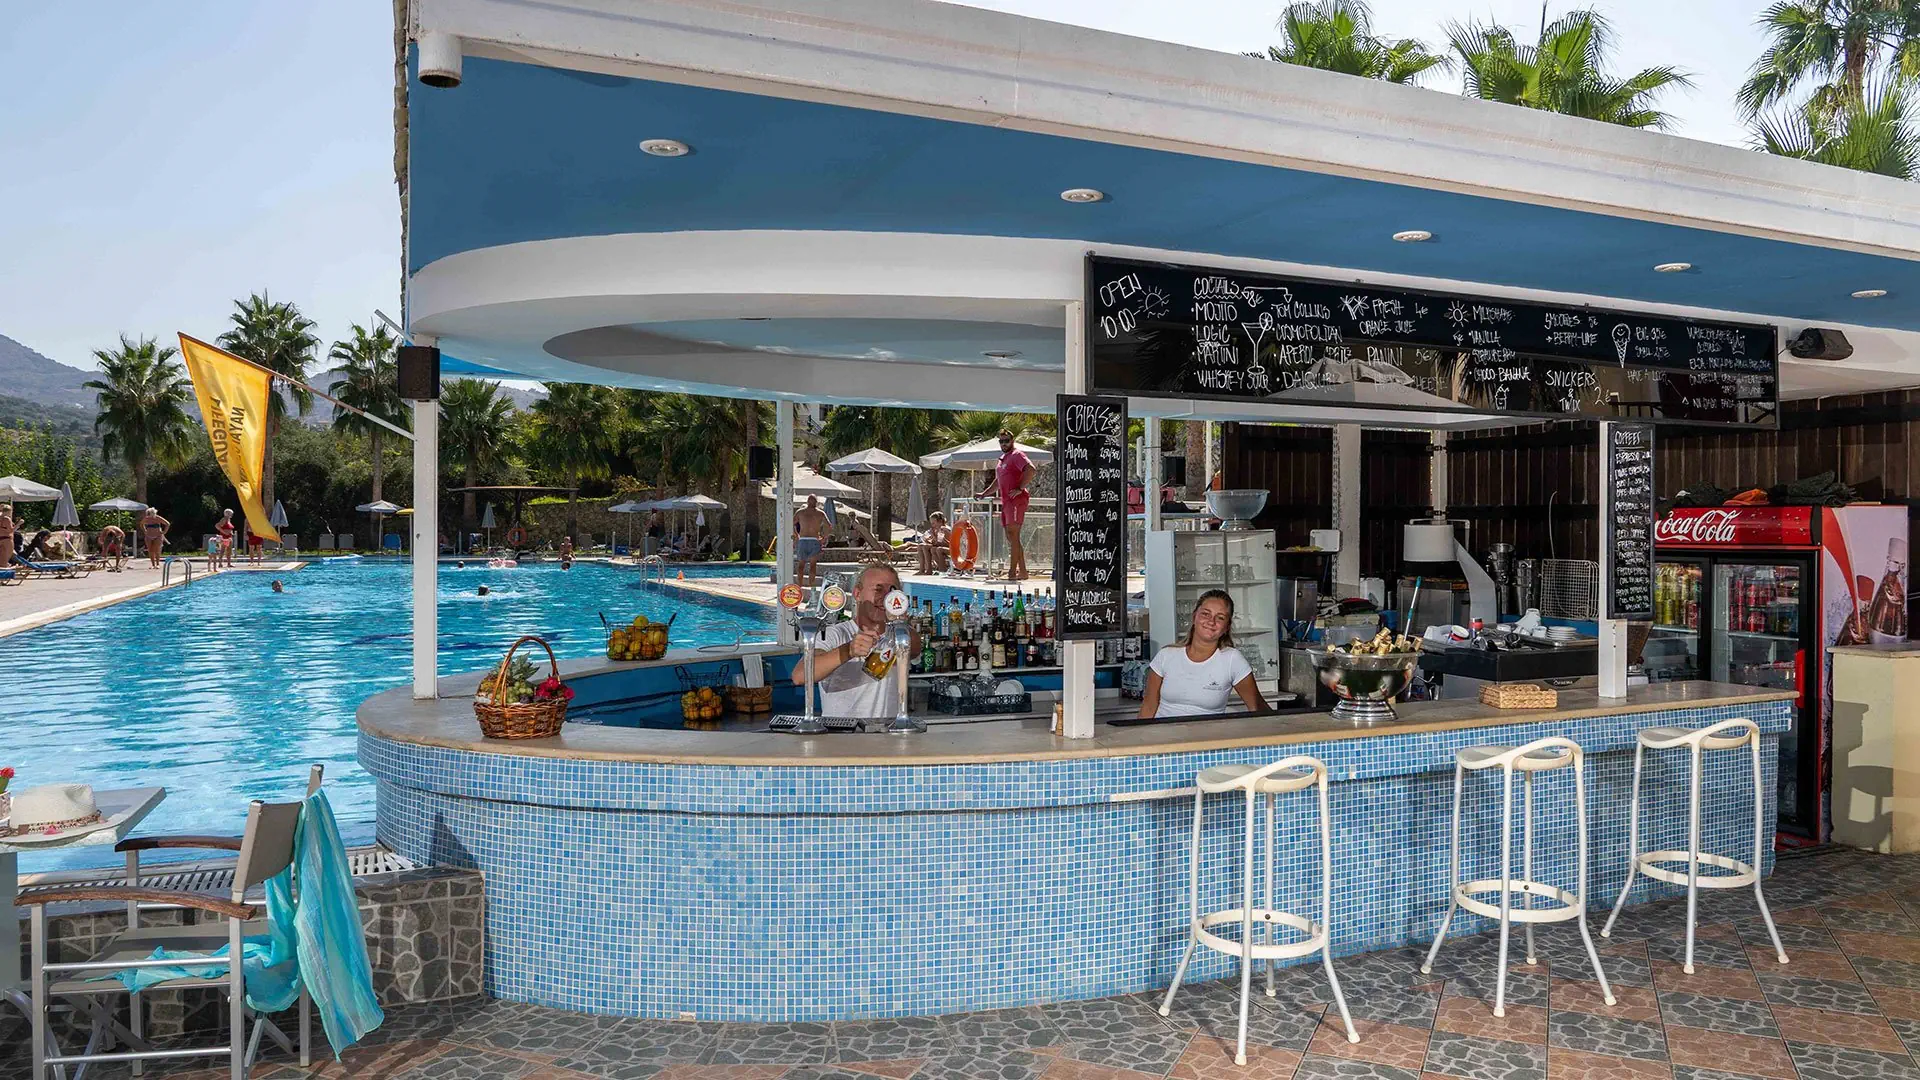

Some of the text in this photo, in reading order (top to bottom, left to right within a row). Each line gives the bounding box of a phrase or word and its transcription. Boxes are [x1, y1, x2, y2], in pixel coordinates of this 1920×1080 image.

[1099, 272, 1142, 307] OPEN
[1193, 276, 1241, 297] COCTAILS
[1195, 301, 1238, 322] MOJITO
[1271, 301, 1331, 320] TOM COLLINS
[1372, 298, 1404, 319] FRESH
[1275, 323, 1343, 344] COSMOPOLITAN
[1359, 319, 1392, 337] ORANGE
[1471, 330, 1502, 347] VANILLA
[1197, 344, 1239, 366] MARTINI
[1279, 344, 1316, 366] APEROL
[1366, 345, 1403, 367] PANINI
[1197, 370, 1245, 391] WHISKEY
[1545, 369, 1596, 388] SNICKERS
[1559, 397, 1581, 412] TWIX
[1066, 442, 1088, 465] Alpha
[1068, 507, 1096, 529] Mythos
[1068, 526, 1094, 546] Corona
[1069, 566, 1090, 583] Cider
